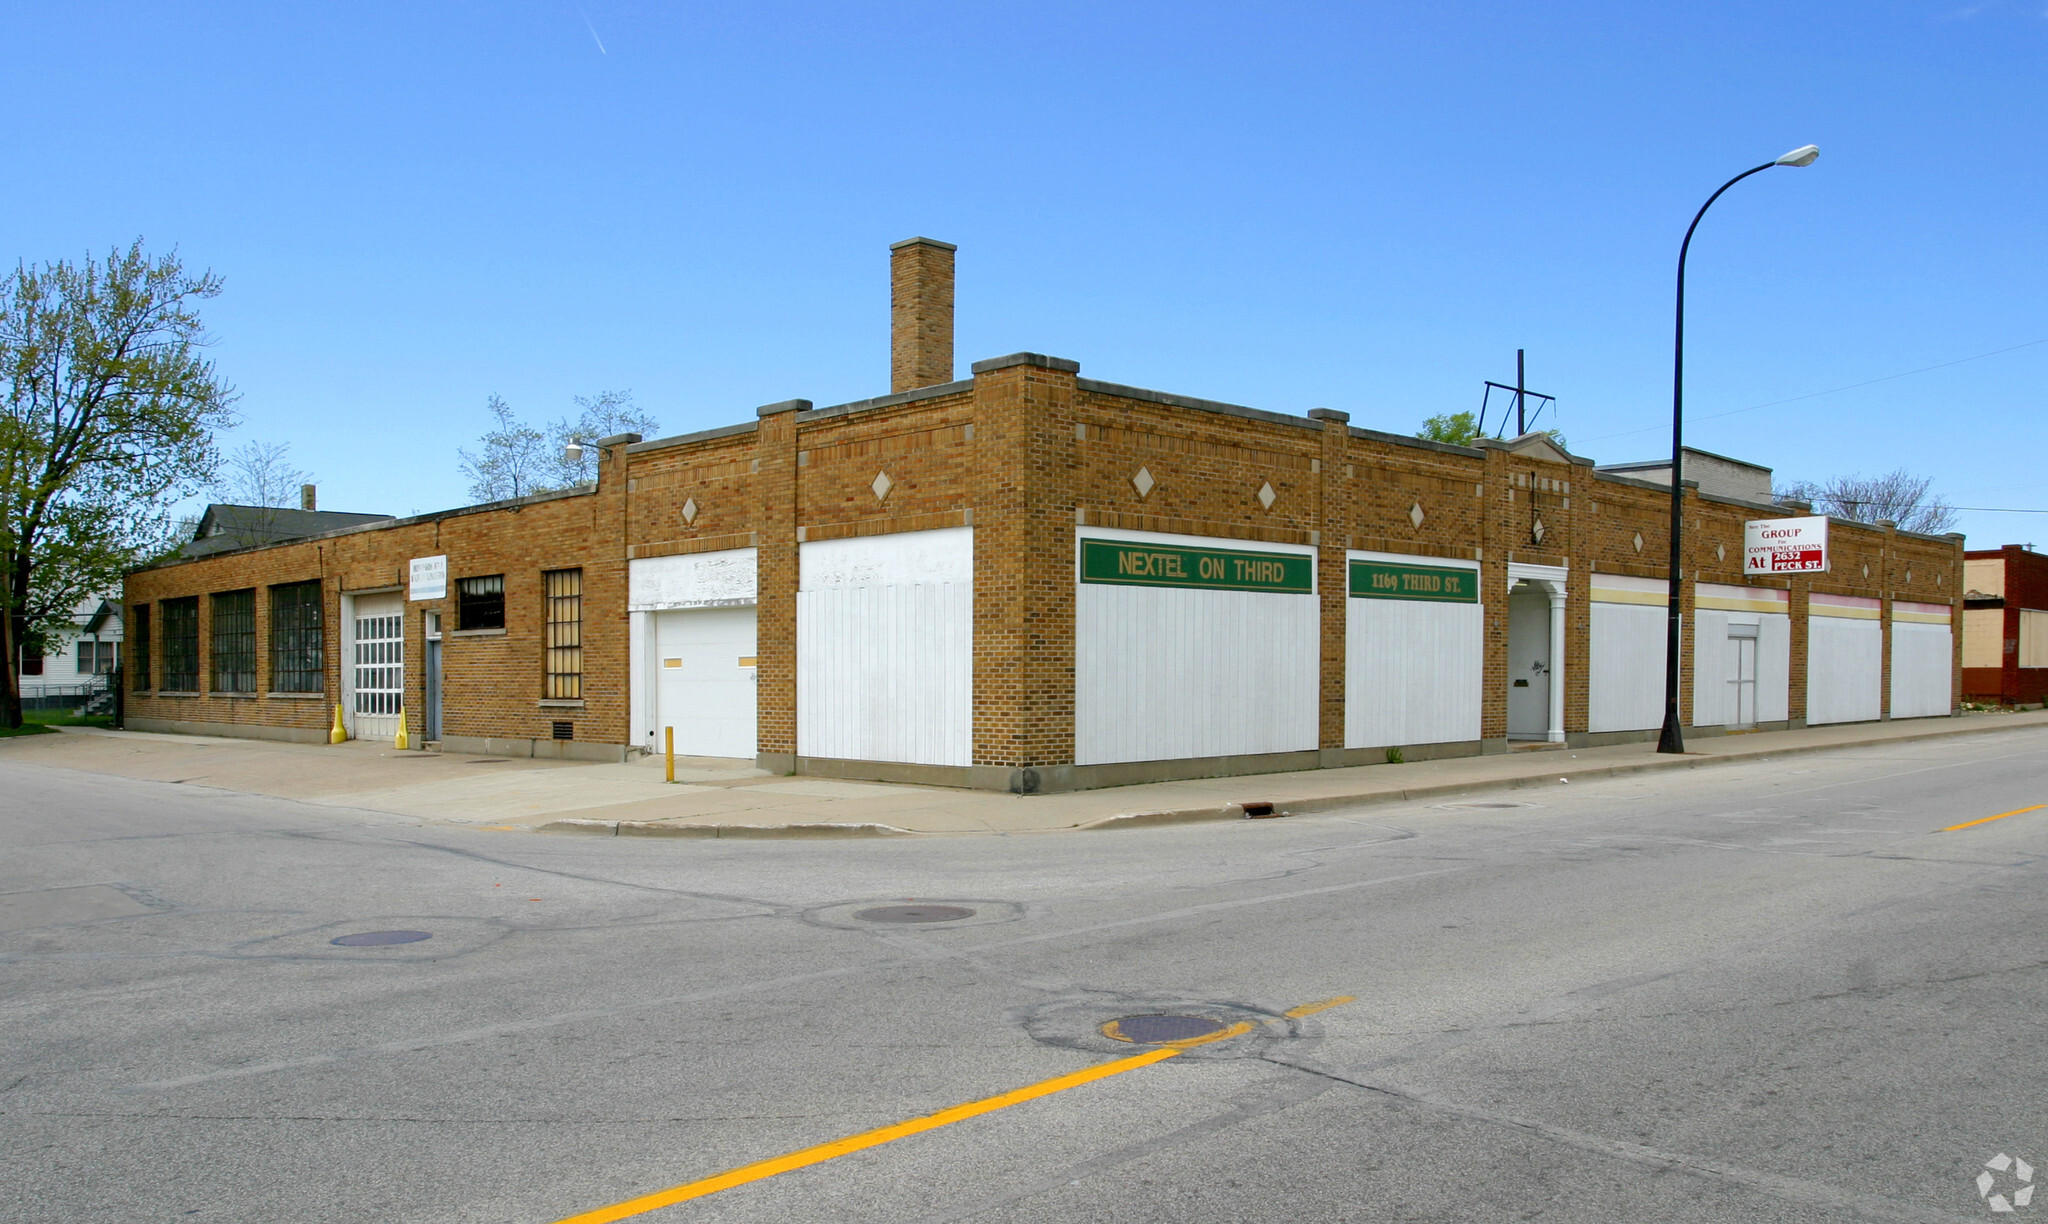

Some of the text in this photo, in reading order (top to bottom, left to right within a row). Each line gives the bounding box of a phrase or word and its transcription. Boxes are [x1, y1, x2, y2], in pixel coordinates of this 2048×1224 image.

[1761, 529, 1802, 539] GROUP
[1748, 543, 1822, 553] COMMUNICATIONS
[1774, 551, 1801, 561] 2632
[1118, 551, 1285, 583] NEXTEL ON THIRD
[1748, 556, 1766, 569] At
[1774, 560, 1822, 571] PECK ST.
[1371, 573, 1461, 593] 1169 THIRD ST.
